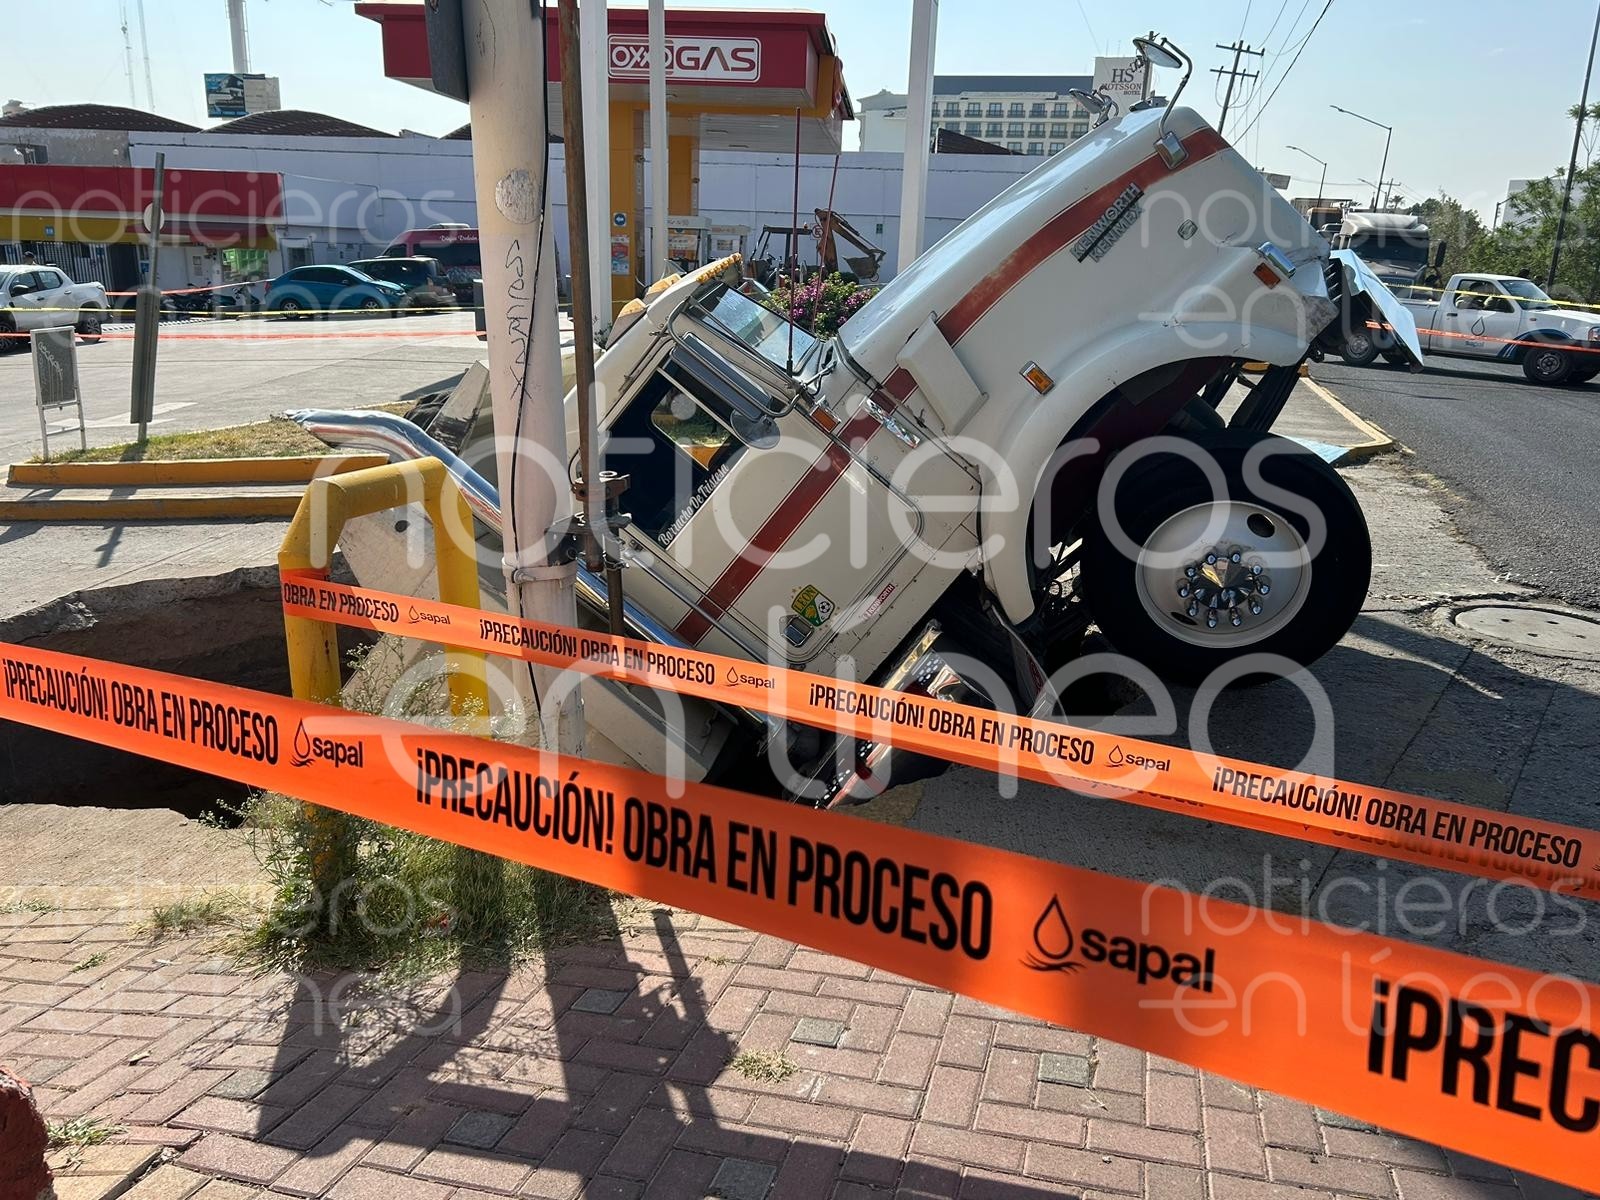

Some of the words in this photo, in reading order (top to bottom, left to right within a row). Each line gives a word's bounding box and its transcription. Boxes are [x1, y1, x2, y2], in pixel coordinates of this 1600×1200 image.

[1111, 68, 1134, 83] HS
[1070, 181, 1141, 259] KENWORTH
[1088, 203, 1143, 263] KENMEX
[657, 508, 694, 546] Borracho
[697, 463, 729, 498] Tristesa
[283, 580, 316, 608] OBRA
[319, 588, 337, 612] EN
[339, 592, 399, 623] PROCESO
[420, 609, 451, 627] sapal
[479, 616, 577, 660] ¡PRECAUCIÓN!
[581, 634, 619, 669] OBRA
[624, 642, 643, 672] EN
[646, 645, 715, 686] PROCESO
[740, 671, 775, 690] sapal
[4, 660, 108, 720] ¡PRECAUCIÓN!
[112, 681, 158, 737] OBRA
[162, 693, 187, 742] EN
[190, 697, 278, 766] PROCESO
[809, 683, 924, 729] ¡PRECAUCIÓN!
[928, 704, 978, 740] OBRA
[981, 718, 1005, 747] EN
[1009, 723, 1095, 766] PROCESO
[312, 735, 364, 769] sapal
[1125, 752, 1170, 772] sapal
[1213, 765, 1360, 822] ¡PRECAUCIÓN!
[1365, 797, 1428, 837] OBRA
[1434, 812, 1467, 845] EN
[1471, 818, 1582, 868] PROCESO
[417, 748, 614, 853] ¡PRECAUCIÓN!
[624, 798, 716, 882] OBRA
[727, 825, 779, 901] EN
[788, 834, 993, 962] PROCESO
[1080, 927, 1216, 993] sapal
